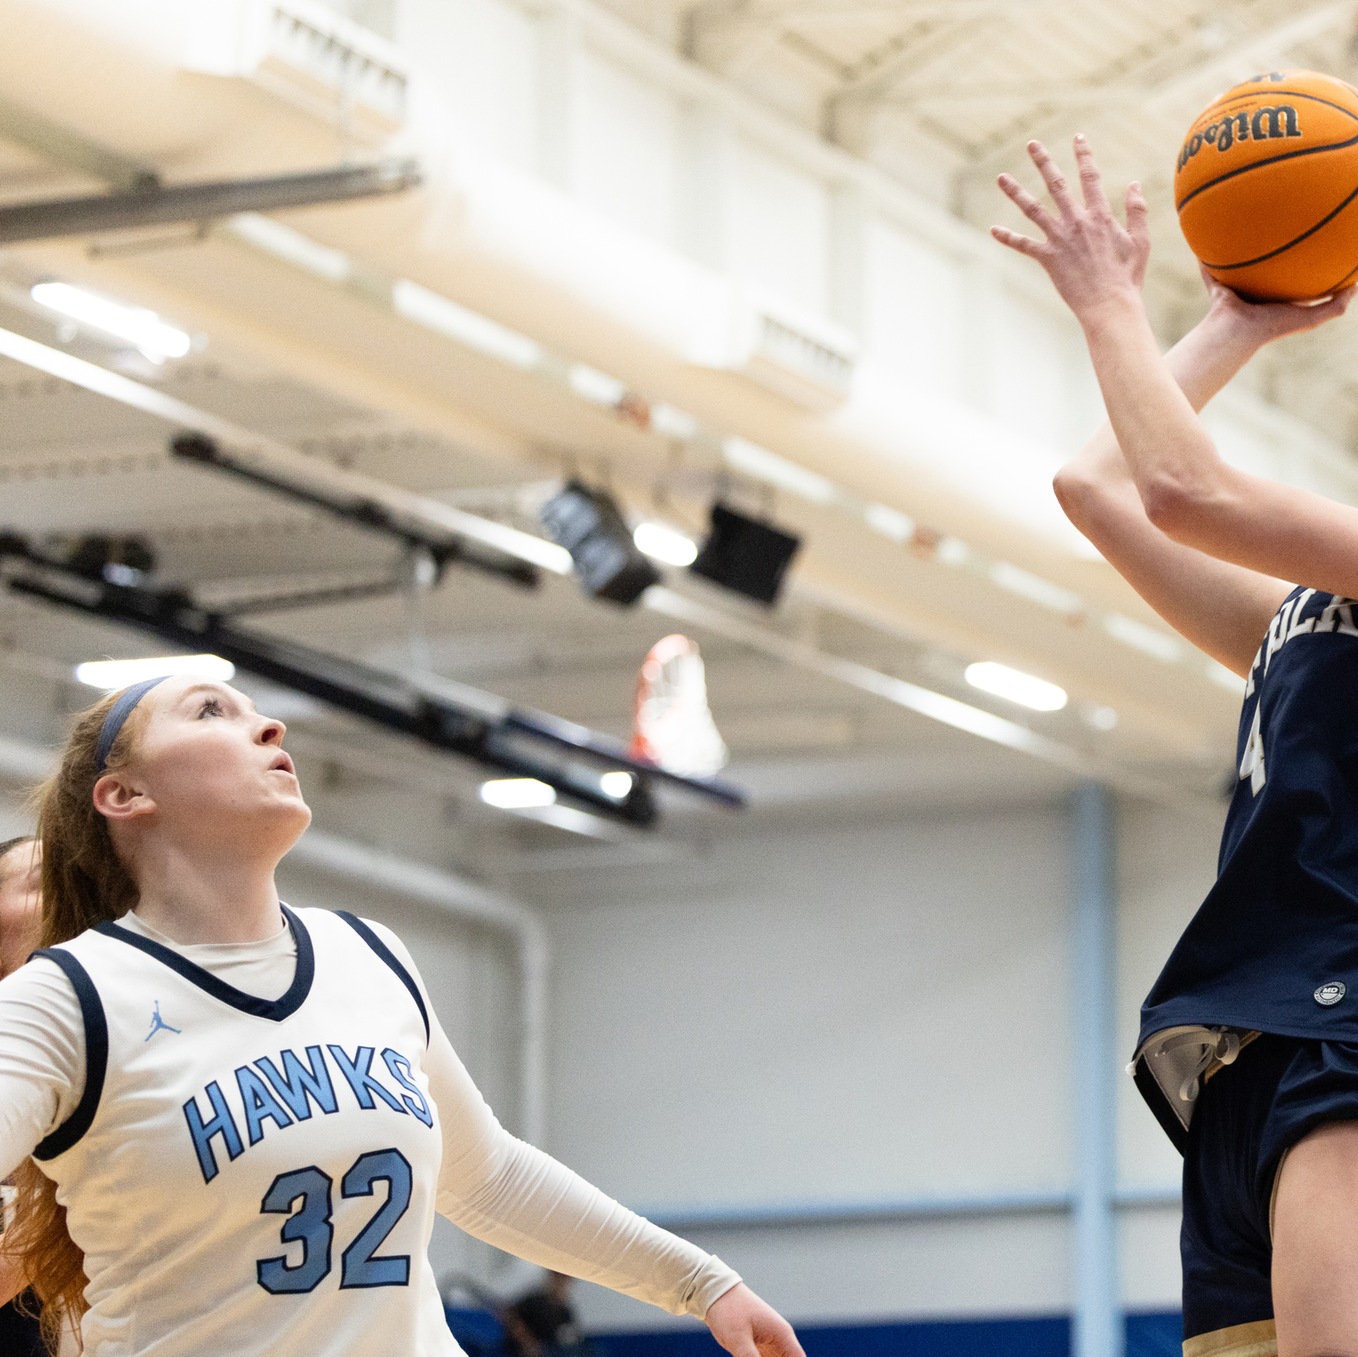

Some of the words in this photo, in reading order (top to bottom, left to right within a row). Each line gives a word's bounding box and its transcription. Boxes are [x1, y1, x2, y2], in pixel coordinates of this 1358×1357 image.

[1177, 104, 1303, 174] Wilson
[182, 1044, 434, 1185] HAWKS
[256, 1147, 413, 1295] 32
